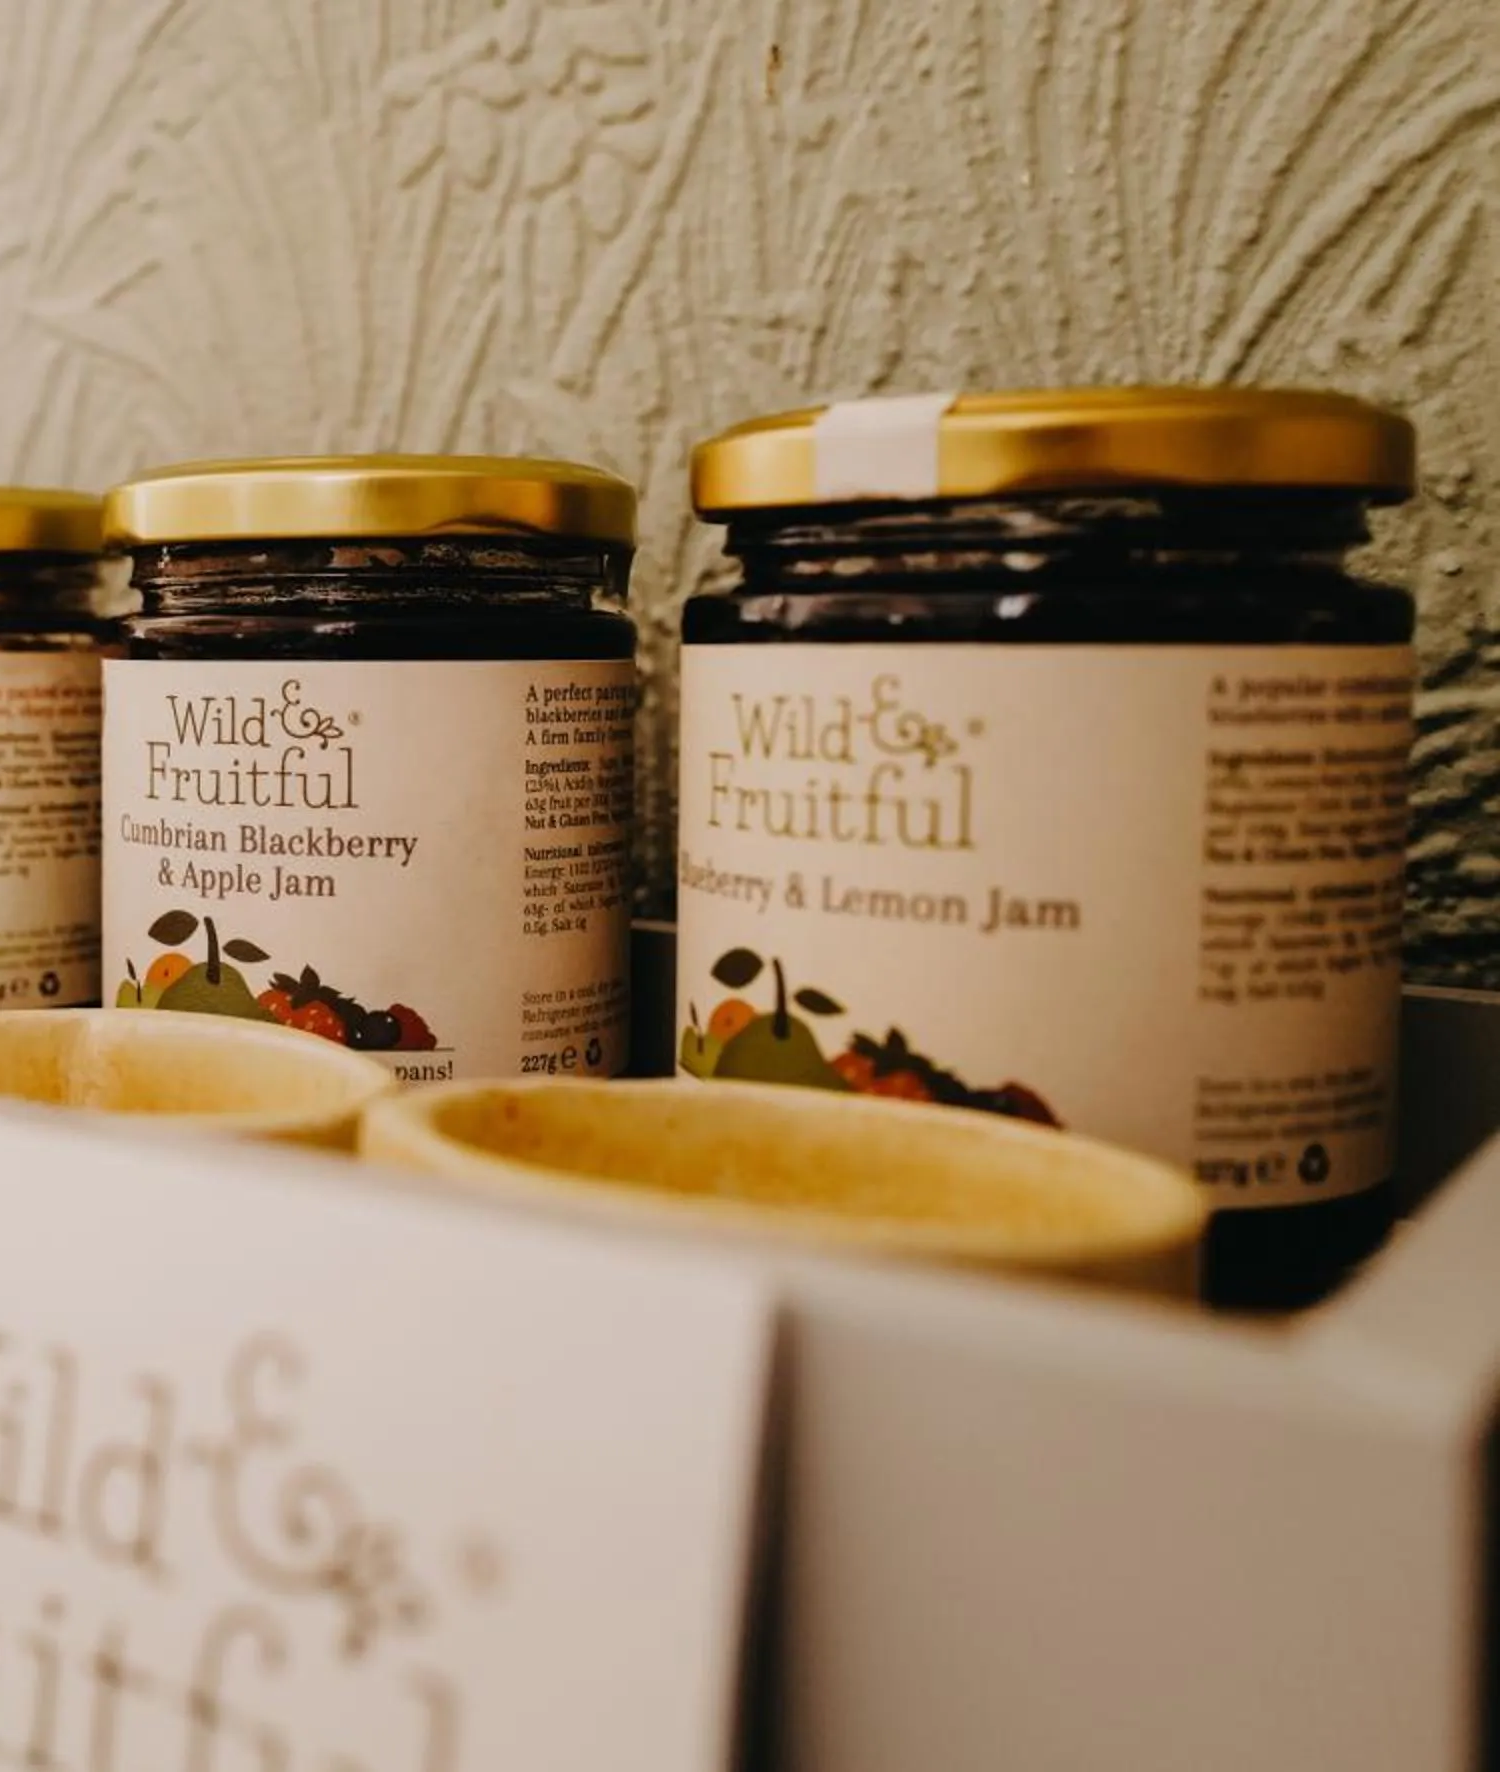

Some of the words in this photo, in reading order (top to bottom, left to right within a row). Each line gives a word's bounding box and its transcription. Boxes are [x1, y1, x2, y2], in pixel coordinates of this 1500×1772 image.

[164, 694, 272, 748] Wild
[269, 678, 345, 750] &
[526, 684, 538, 702] A
[730, 692, 856, 764] Wild
[855, 672, 960, 768] &
[526, 729, 537, 745] A
[143, 740, 362, 810] Fruitful
[705, 750, 977, 851] Fruitful
[120, 813, 227, 852] Cumbrian
[238, 821, 419, 867] Blackberry
[156, 856, 174, 887] &
[180, 860, 262, 900] Apple
[268, 865, 337, 901] Jam
[820, 875, 969, 925] Lemon
[980, 883, 1082, 933] Jam
[393, 1060, 454, 1082] pans!
[521, 1052, 558, 1074] 227g
[178, 1322, 436, 1664] &
